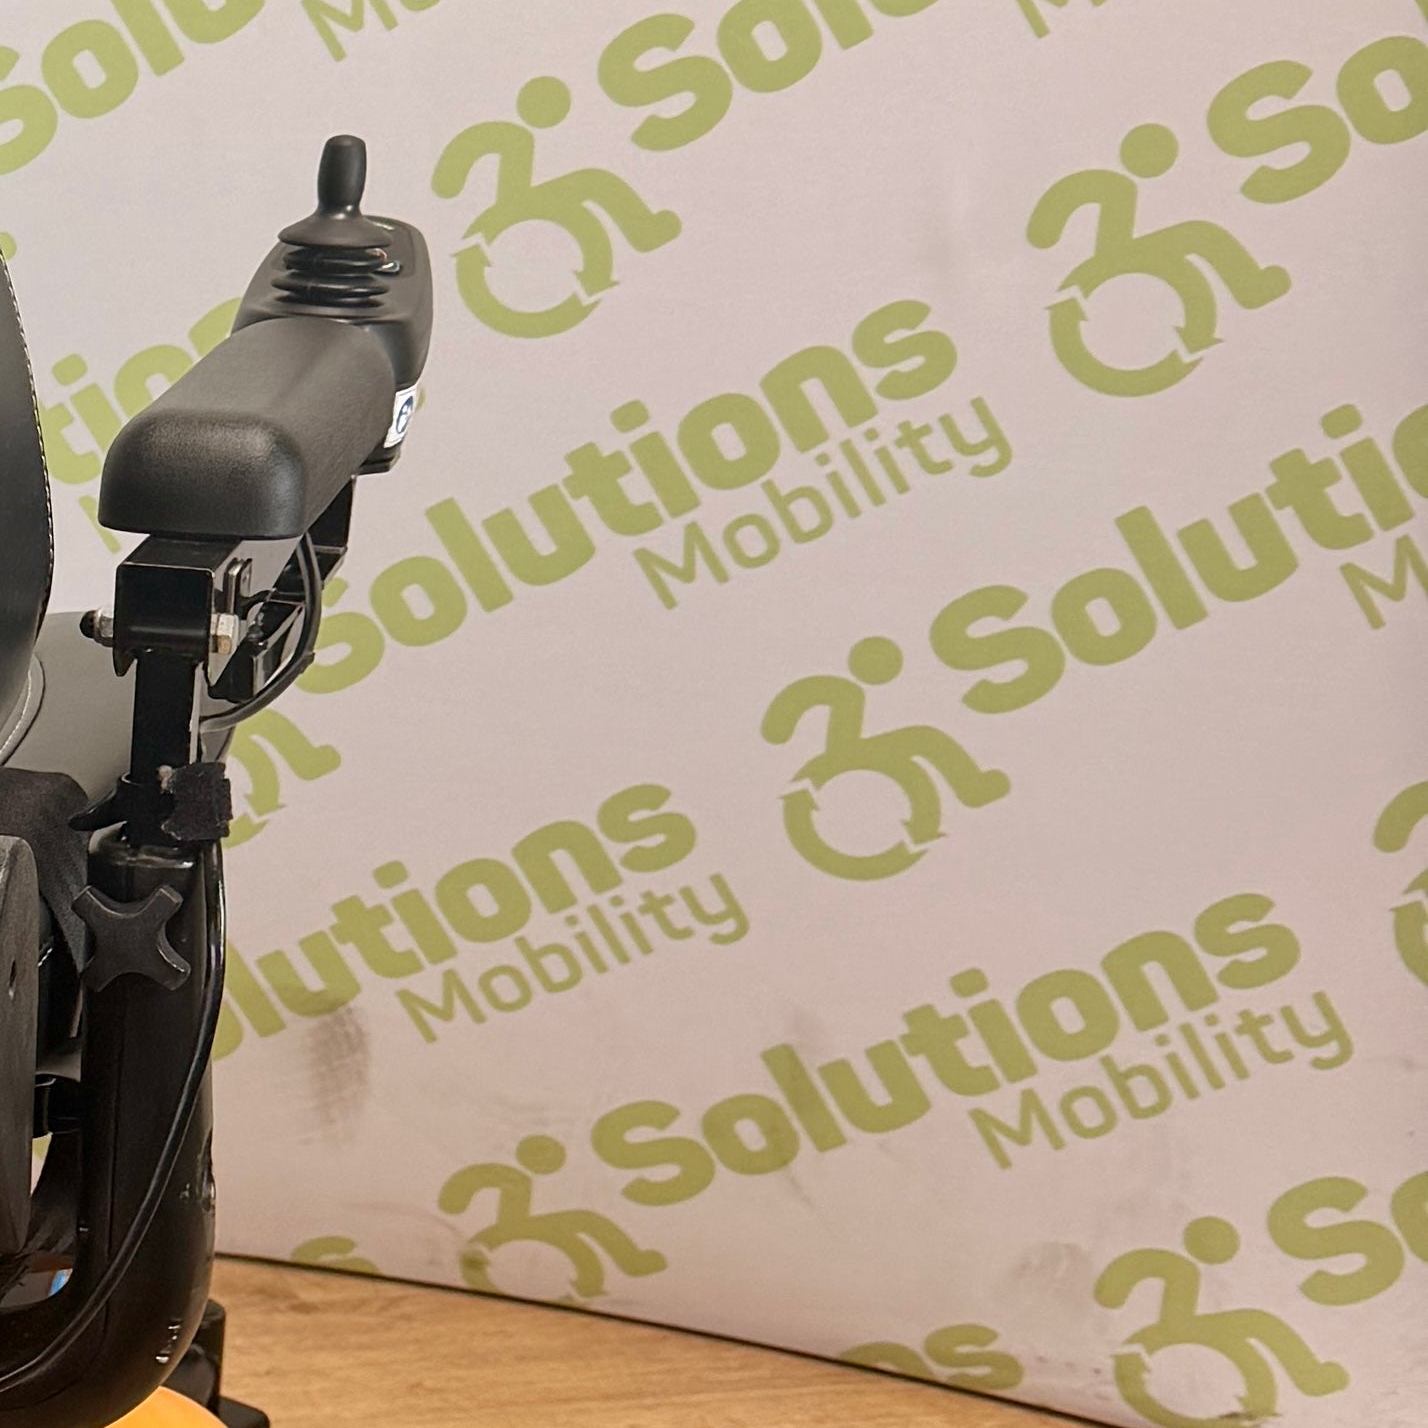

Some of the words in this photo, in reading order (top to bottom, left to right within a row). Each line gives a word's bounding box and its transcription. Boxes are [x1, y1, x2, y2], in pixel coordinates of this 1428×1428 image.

[293, 299, 959, 696] Solutions
[633, 397, 1013, 610] Mobility
[396, 873, 750, 1045] Mobility
[589, 892, 1301, 1209] Solutions
[968, 991, 1354, 1170] Mobility
